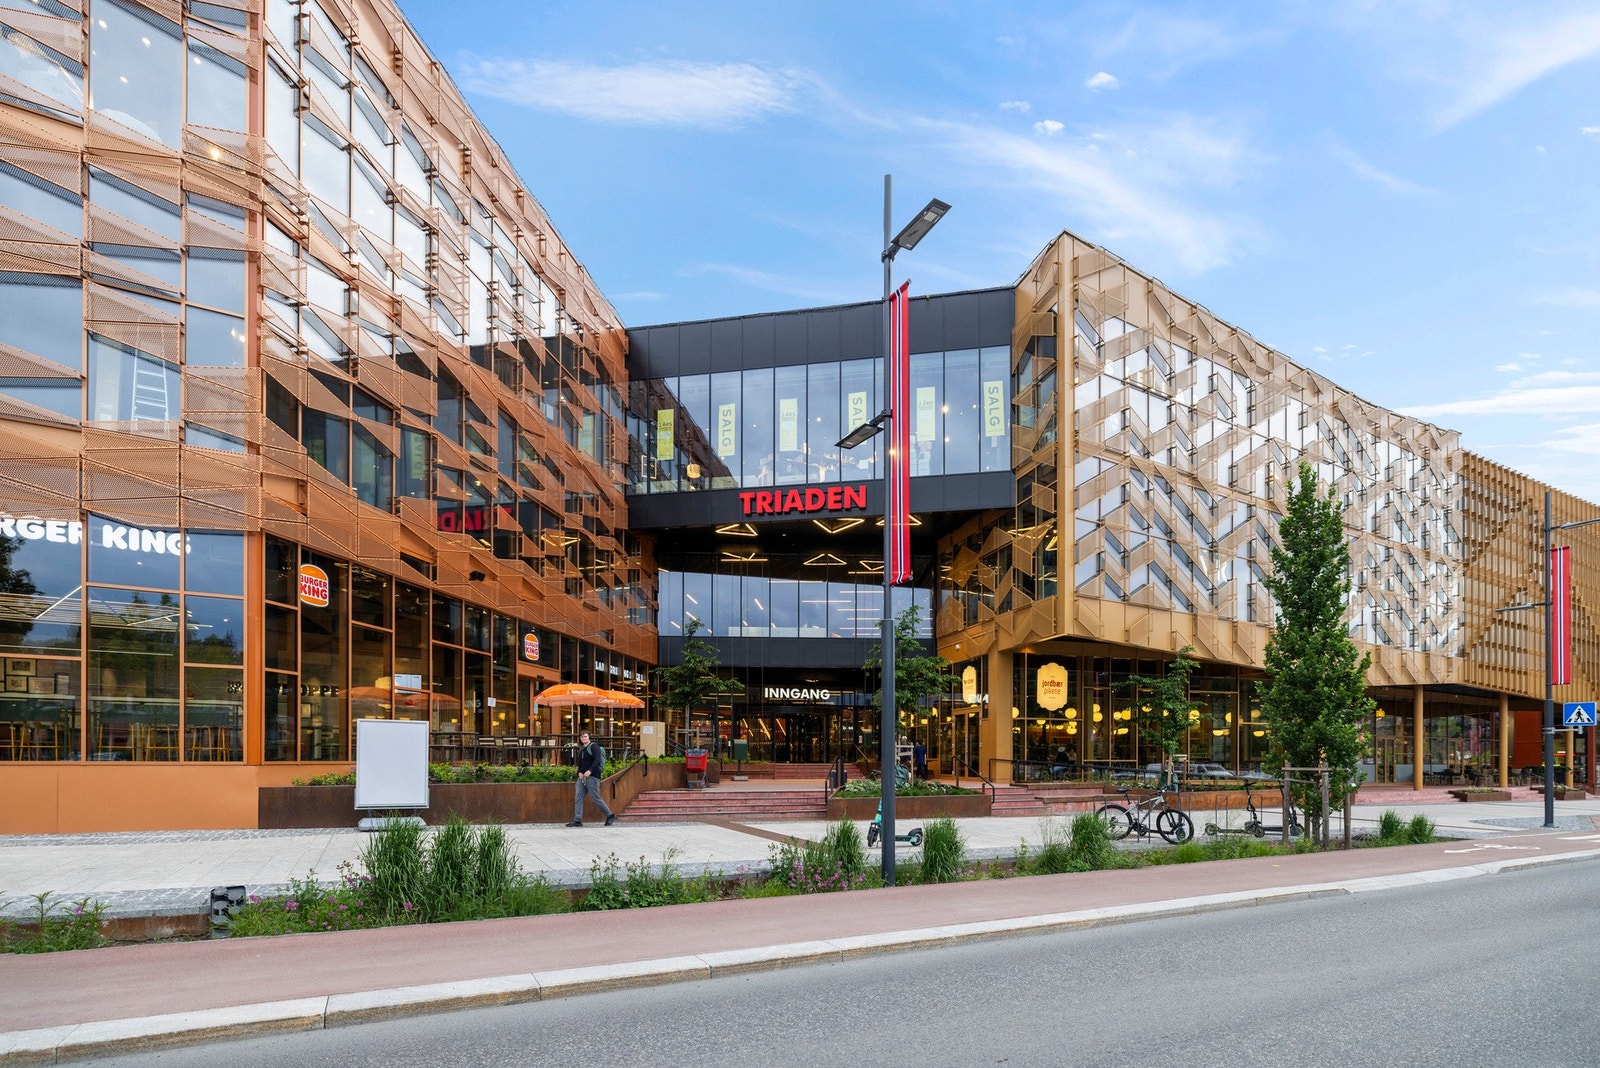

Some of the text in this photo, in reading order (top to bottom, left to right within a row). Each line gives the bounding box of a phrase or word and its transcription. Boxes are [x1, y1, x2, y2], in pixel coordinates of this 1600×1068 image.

[852, 396, 863, 426] SAL
[988, 386, 1001, 427] SALG
[721, 408, 732, 447] SALG
[739, 484, 867, 515] TRIADEN
[102, 524, 192, 557] KING
[300, 574, 328, 590] BURGER
[300, 583, 328, 600] KING
[525, 646, 539, 656] KING
[1042, 679, 1064, 689] jordbær
[1044, 687, 1061, 696] pikene
[764, 687, 831, 700] INNGANG
